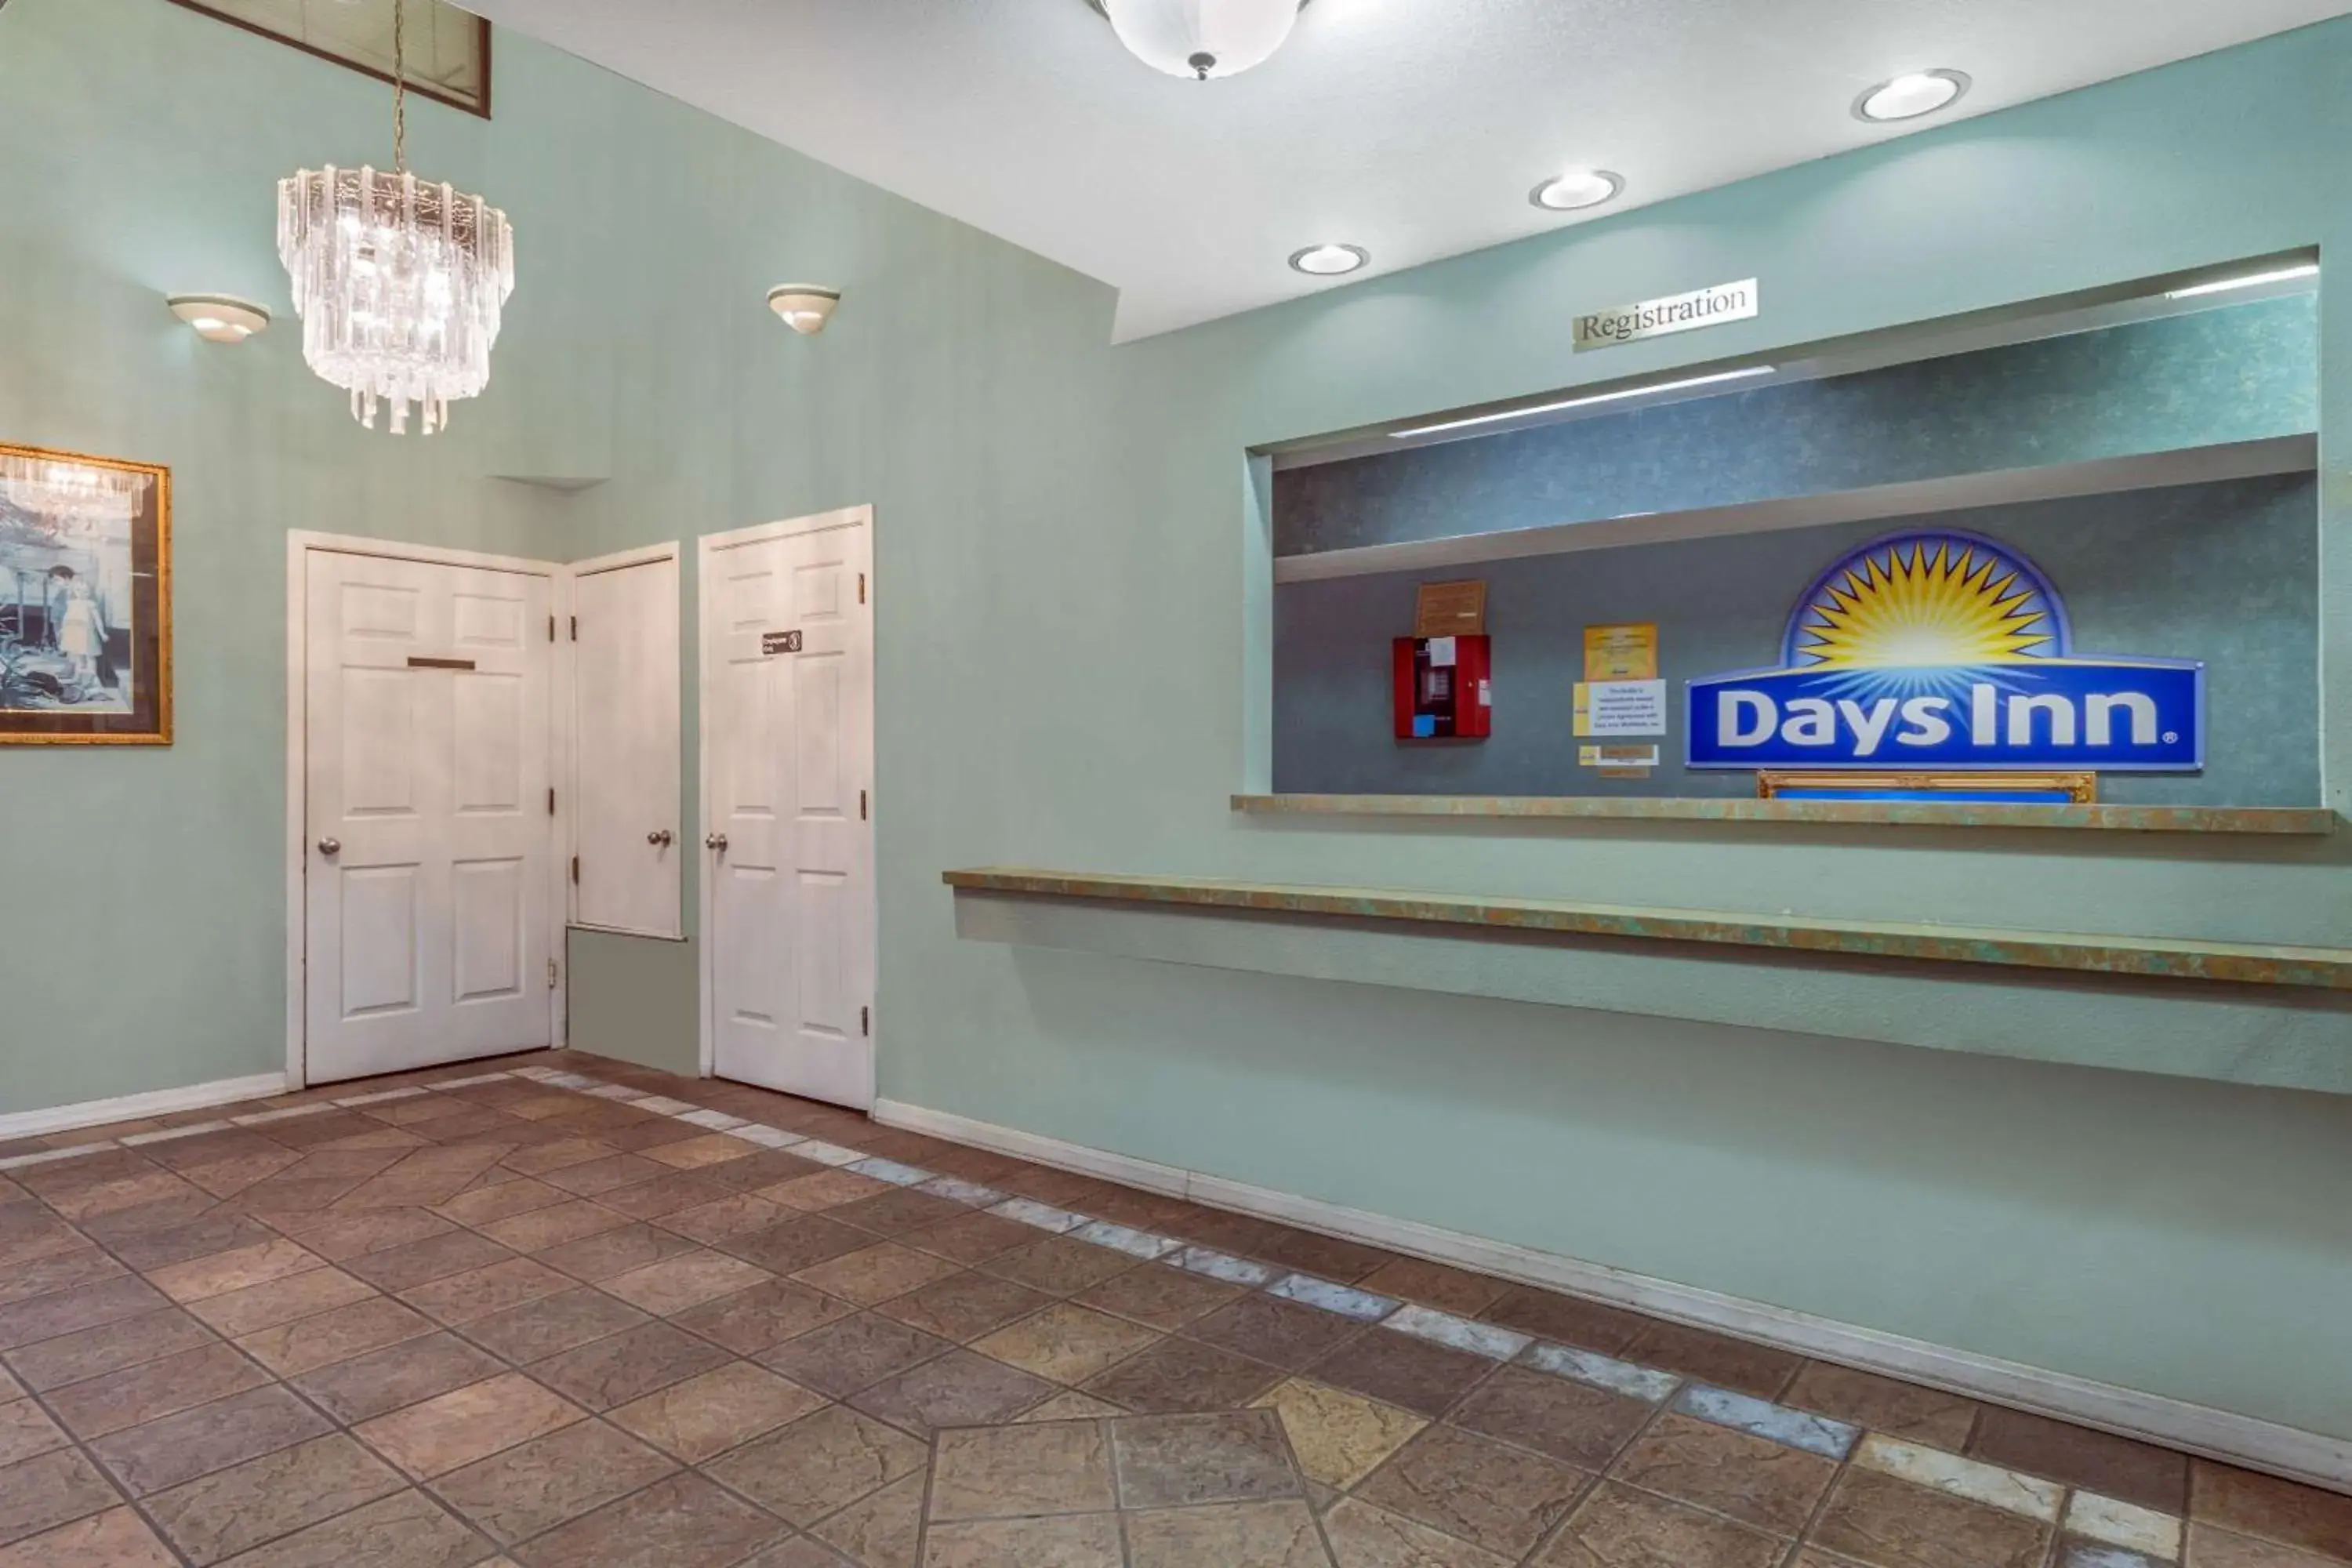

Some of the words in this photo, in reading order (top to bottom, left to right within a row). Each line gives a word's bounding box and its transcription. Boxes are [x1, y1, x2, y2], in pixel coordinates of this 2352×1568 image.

[1581, 288, 1747, 340] Registration
[1718, 690, 1951, 756] Days
[1972, 683, 2157, 746] Inn
